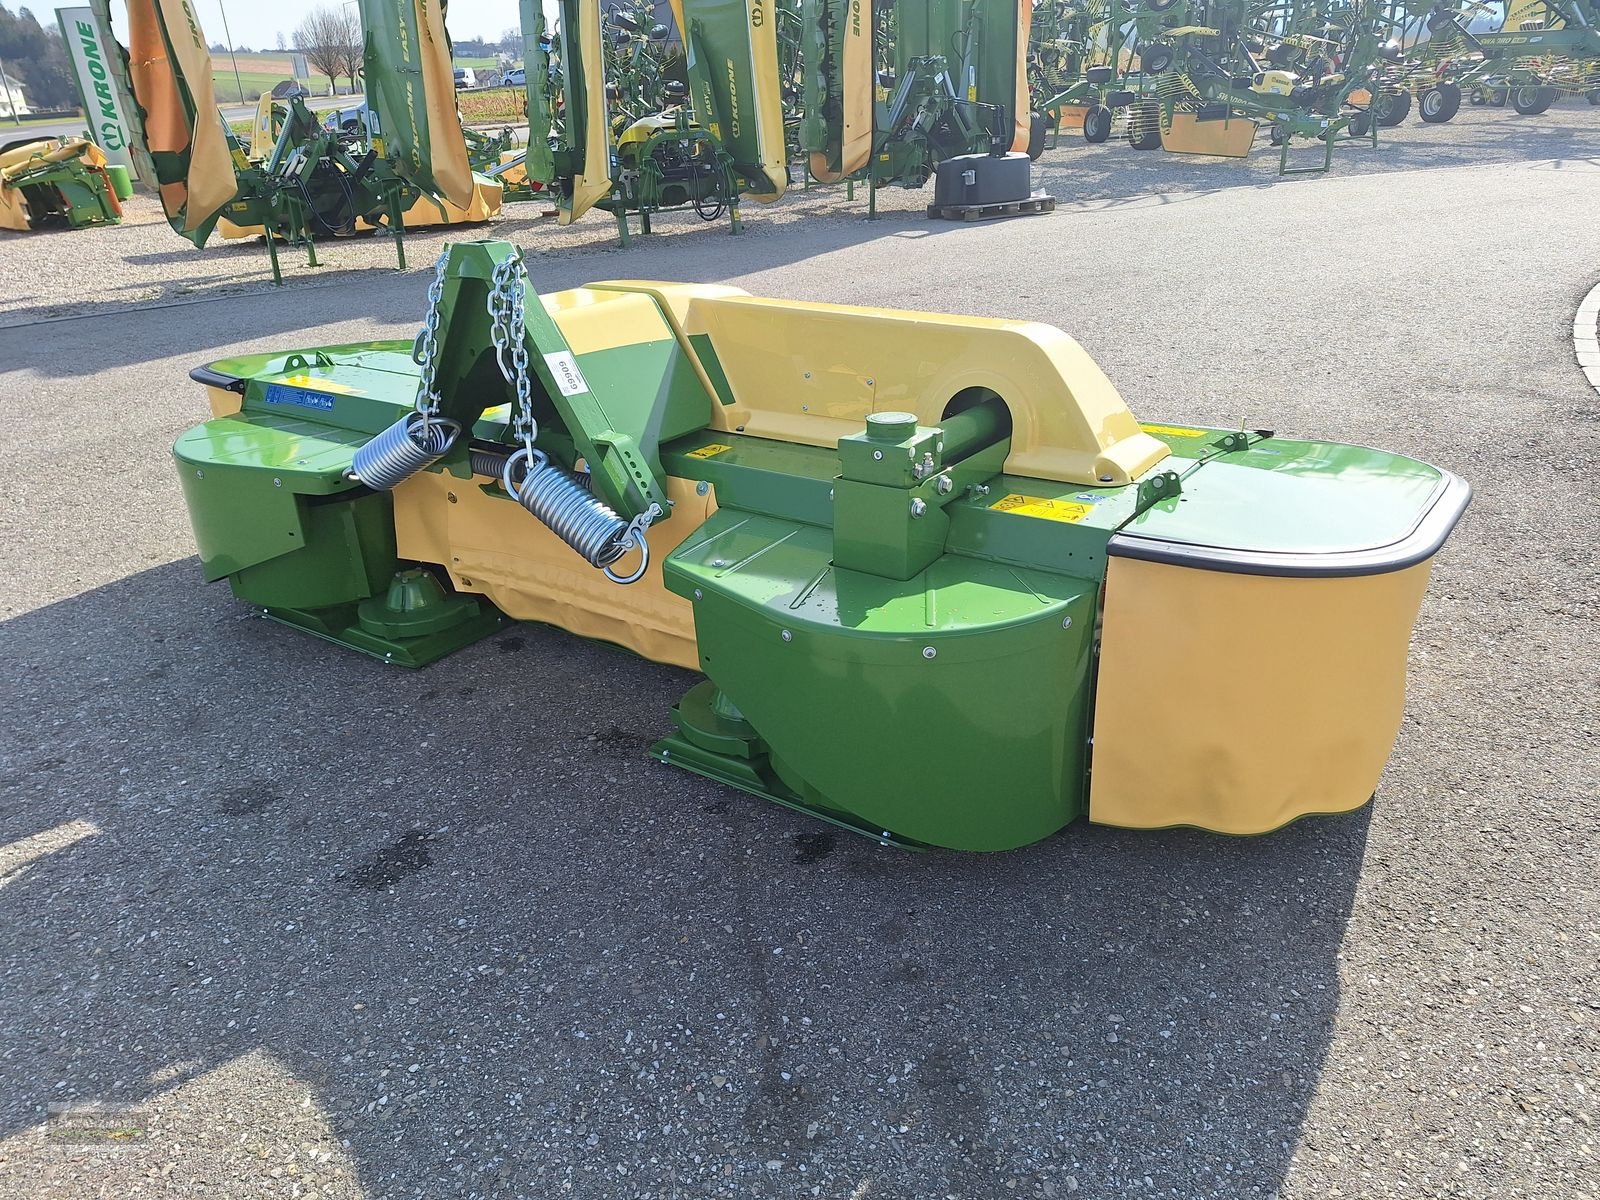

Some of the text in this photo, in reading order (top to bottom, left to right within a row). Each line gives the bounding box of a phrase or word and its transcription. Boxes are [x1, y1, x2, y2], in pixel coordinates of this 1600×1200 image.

[75, 20, 119, 121] KRONE
[727, 58, 739, 120] KRONE
[558, 361, 578, 390] 60669
